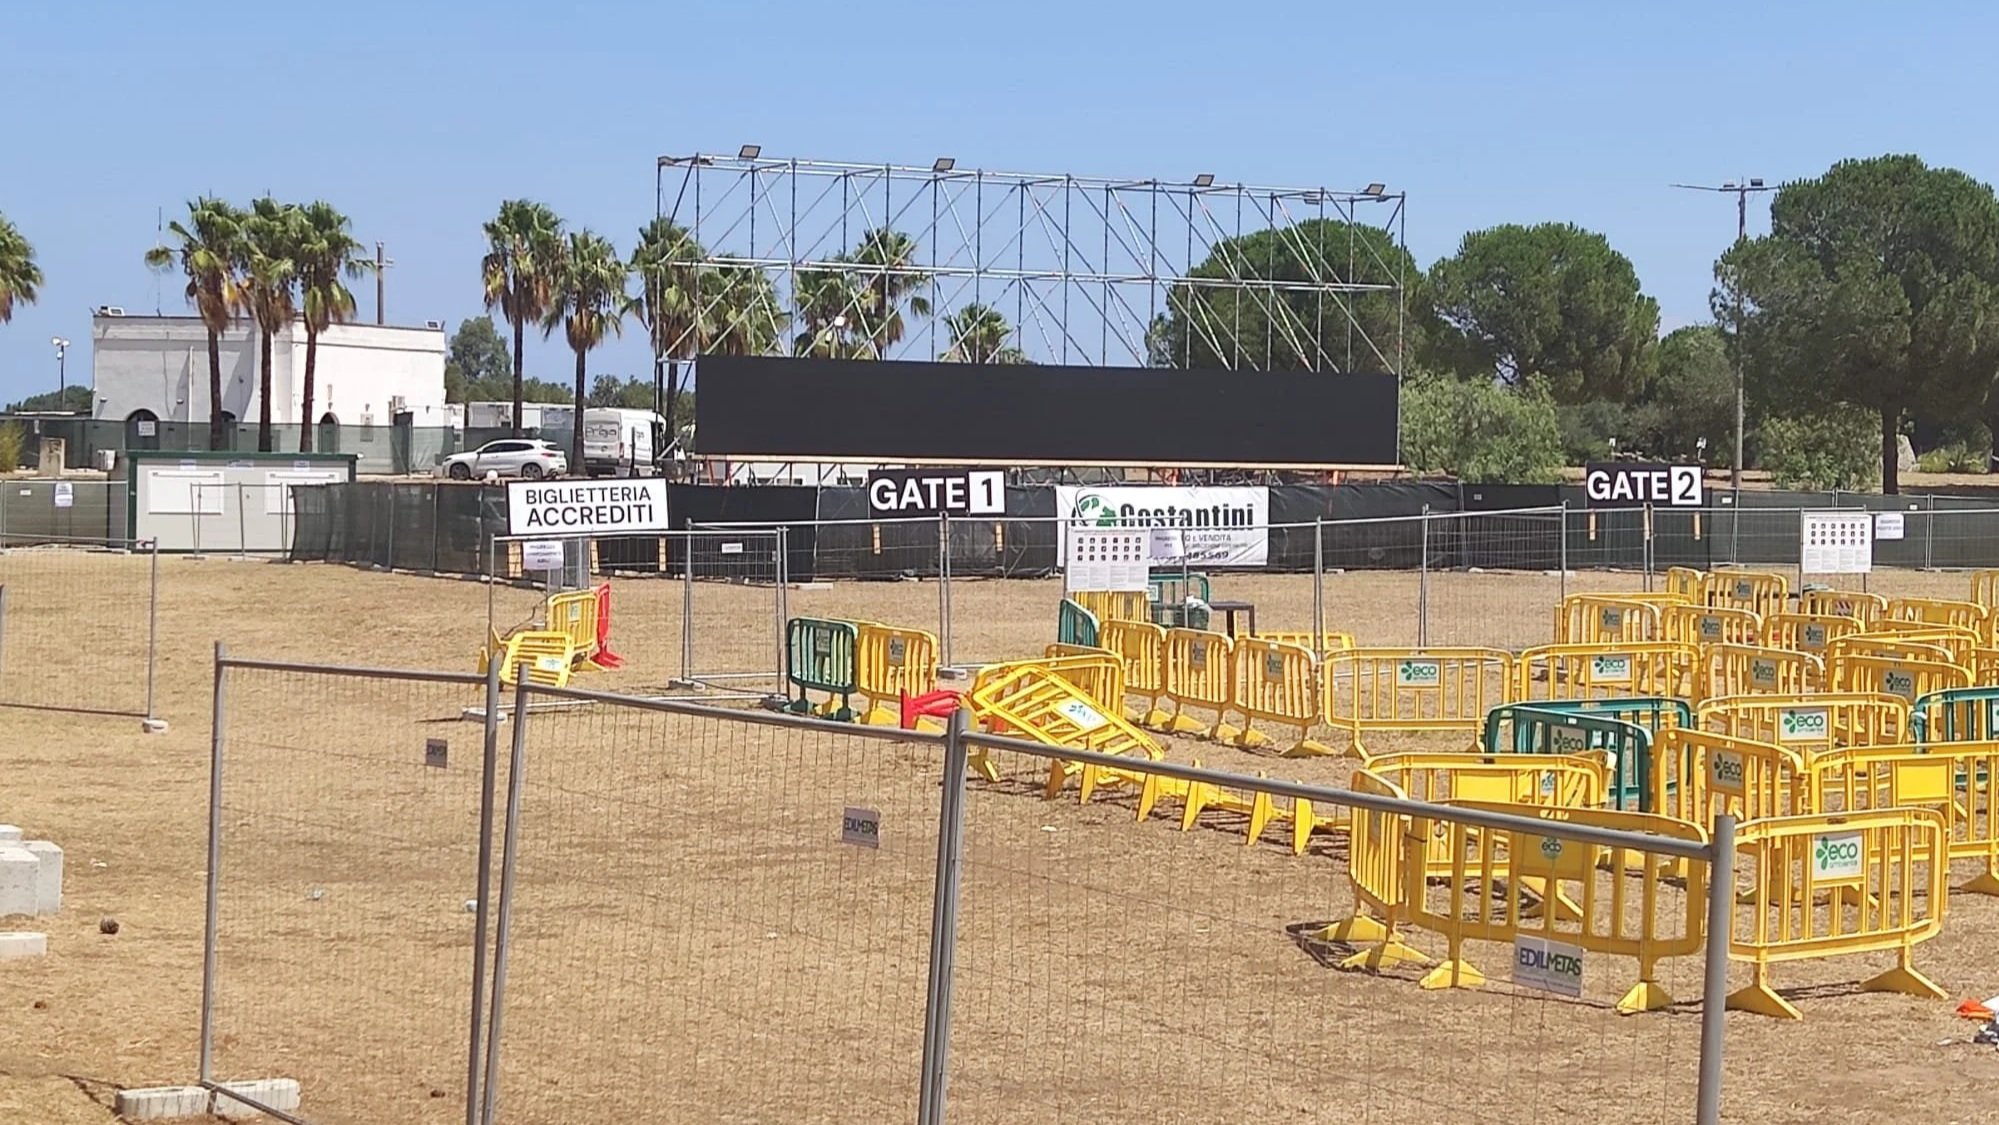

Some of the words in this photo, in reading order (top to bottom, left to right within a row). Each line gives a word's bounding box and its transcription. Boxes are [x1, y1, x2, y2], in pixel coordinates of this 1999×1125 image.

[1587, 470, 1669, 501] GATE
[1677, 471, 1696, 501] 2
[526, 486, 651, 505] BIGLIETTERIA
[870, 477, 966, 511] GATE
[981, 477, 993, 507] 1
[527, 504, 653, 527] ACCREDITI
[1120, 503, 1254, 531] Costantini
[1198, 534, 1232, 542] VENDITA
[1413, 665, 1437, 676] eco
[1604, 658, 1626, 669] eco
[1893, 677, 1911, 689] eco
[1796, 716, 1824, 727] eco
[1563, 737, 1583, 750] eco
[1723, 761, 1742, 777] eco
[1542, 842, 1562, 852] eco
[1828, 842, 1858, 861] eco
[1519, 947, 1582, 976] EDILMETAS
